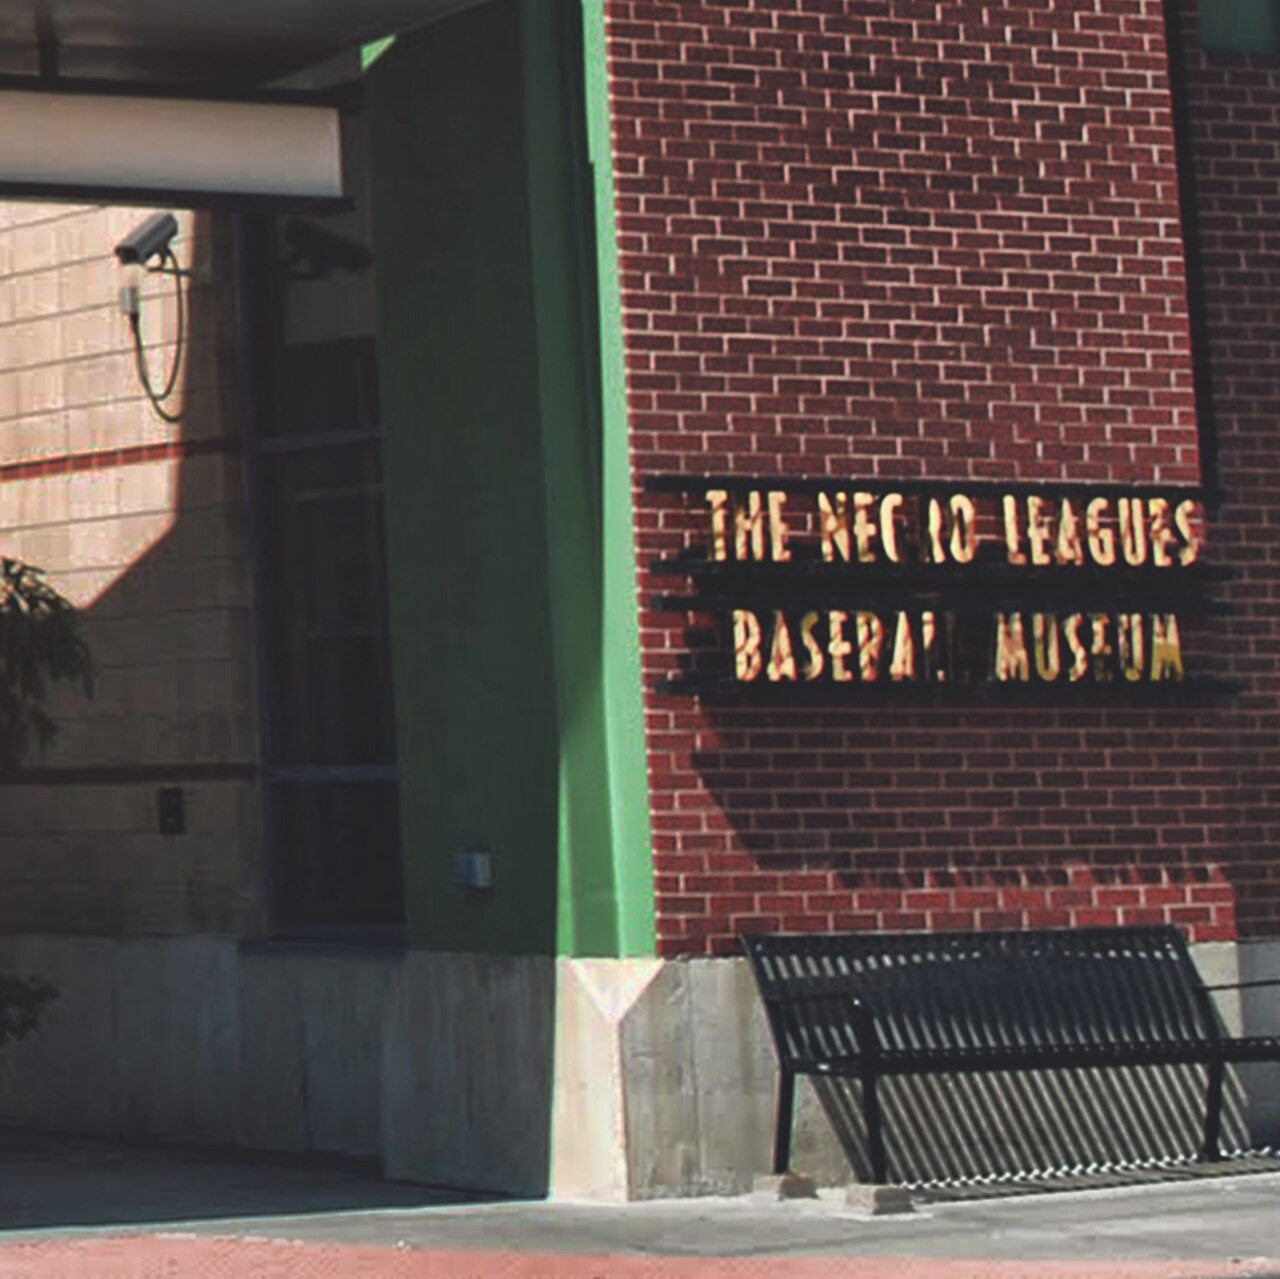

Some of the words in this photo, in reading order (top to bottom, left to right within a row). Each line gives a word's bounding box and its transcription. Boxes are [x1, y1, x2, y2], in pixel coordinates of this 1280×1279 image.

[706, 489, 792, 564] THE
[1002, 493, 1204, 568] LEAGUES
[732, 608, 970, 683] BASEBAL
[995, 610, 1186, 683] MUSEUM
